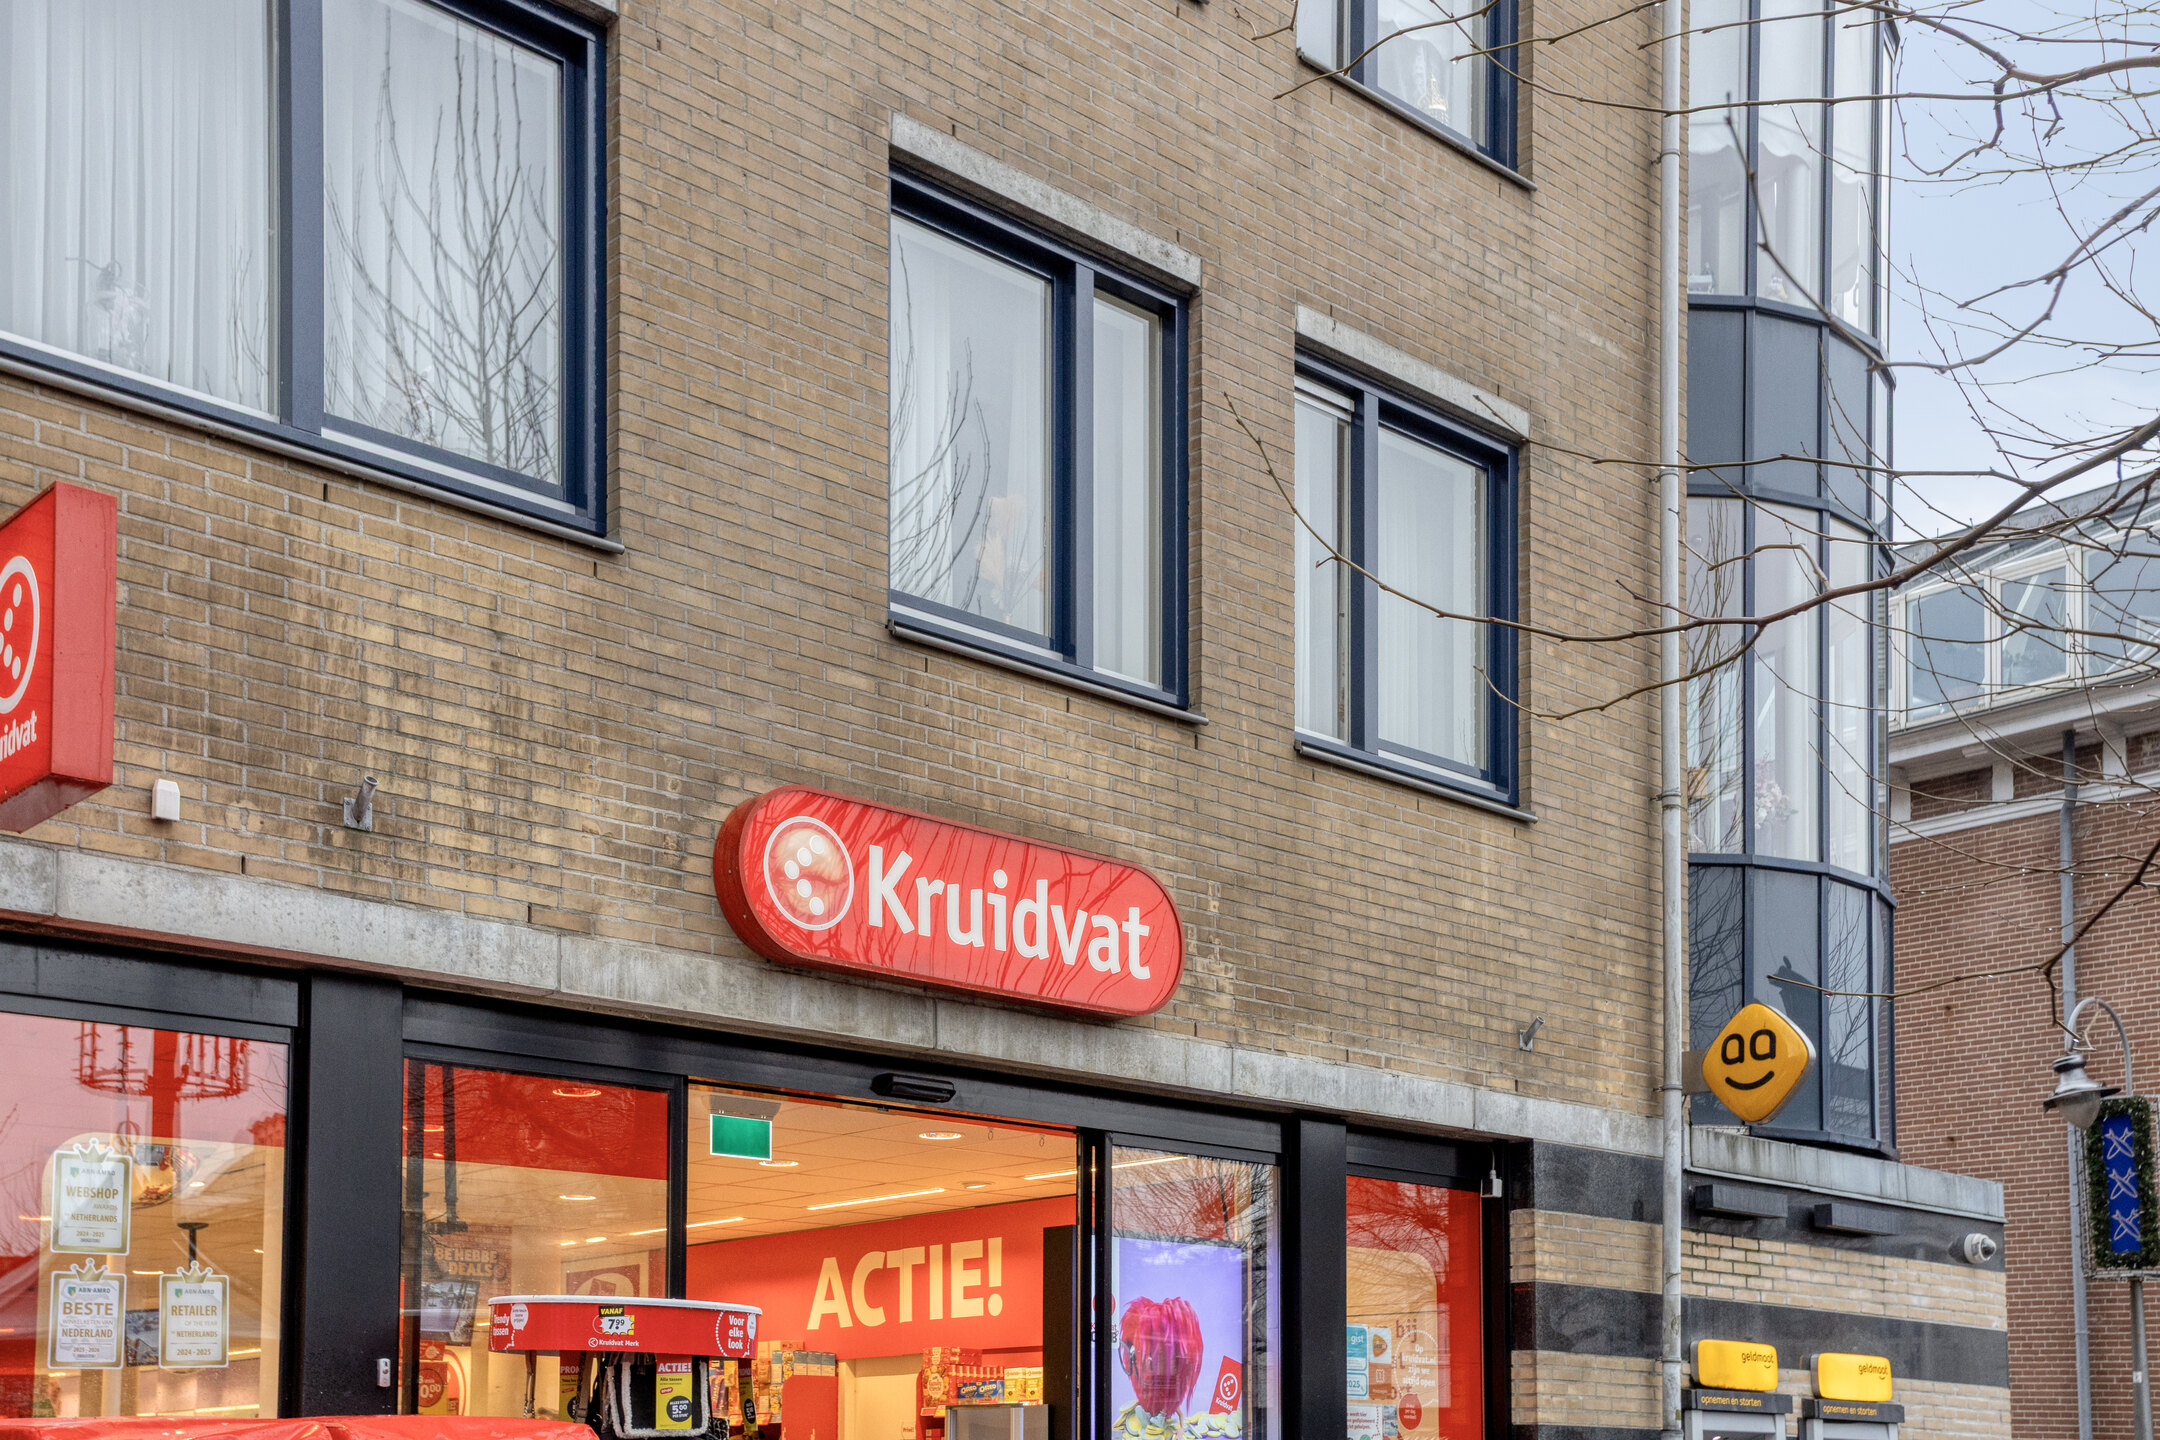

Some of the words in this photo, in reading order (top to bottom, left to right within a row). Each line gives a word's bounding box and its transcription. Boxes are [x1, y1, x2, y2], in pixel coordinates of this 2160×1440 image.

[868, 844, 1151, 980] Kruidvat
[66, 1186, 119, 1199] WEBSHOP
[71, 1213, 118, 1223] NETHERLANDS
[448, 1261, 493, 1277] DEALS
[806, 1237, 1003, 1330] ACTIE!
[63, 1302, 114, 1316] BESTE
[171, 1305, 217, 1316] RETAILER
[728, 1314, 745, 1326] Voor
[61, 1328, 113, 1338] NEDERLAND
[176, 1330, 218, 1338] NETHERLANDS
[728, 1327, 744, 1338] elke
[728, 1338, 743, 1349] look
[1741, 1351, 1774, 1364] geldmaat
[657, 1362, 692, 1373] ACTIE!
[1858, 1363, 1889, 1376] geldmaat
[979, 1383, 997, 1393] OREO
[1215, 1397, 1234, 1412] Kruidvat
[1701, 1395, 1730, 1405] opnemen
[1731, 1397, 1739, 1405] en
[1739, 1397, 1762, 1407] storten
[1823, 1404, 1849, 1415] opnemen
[1850, 1407, 1857, 1415] en
[1857, 1406, 1878, 1416] storten
